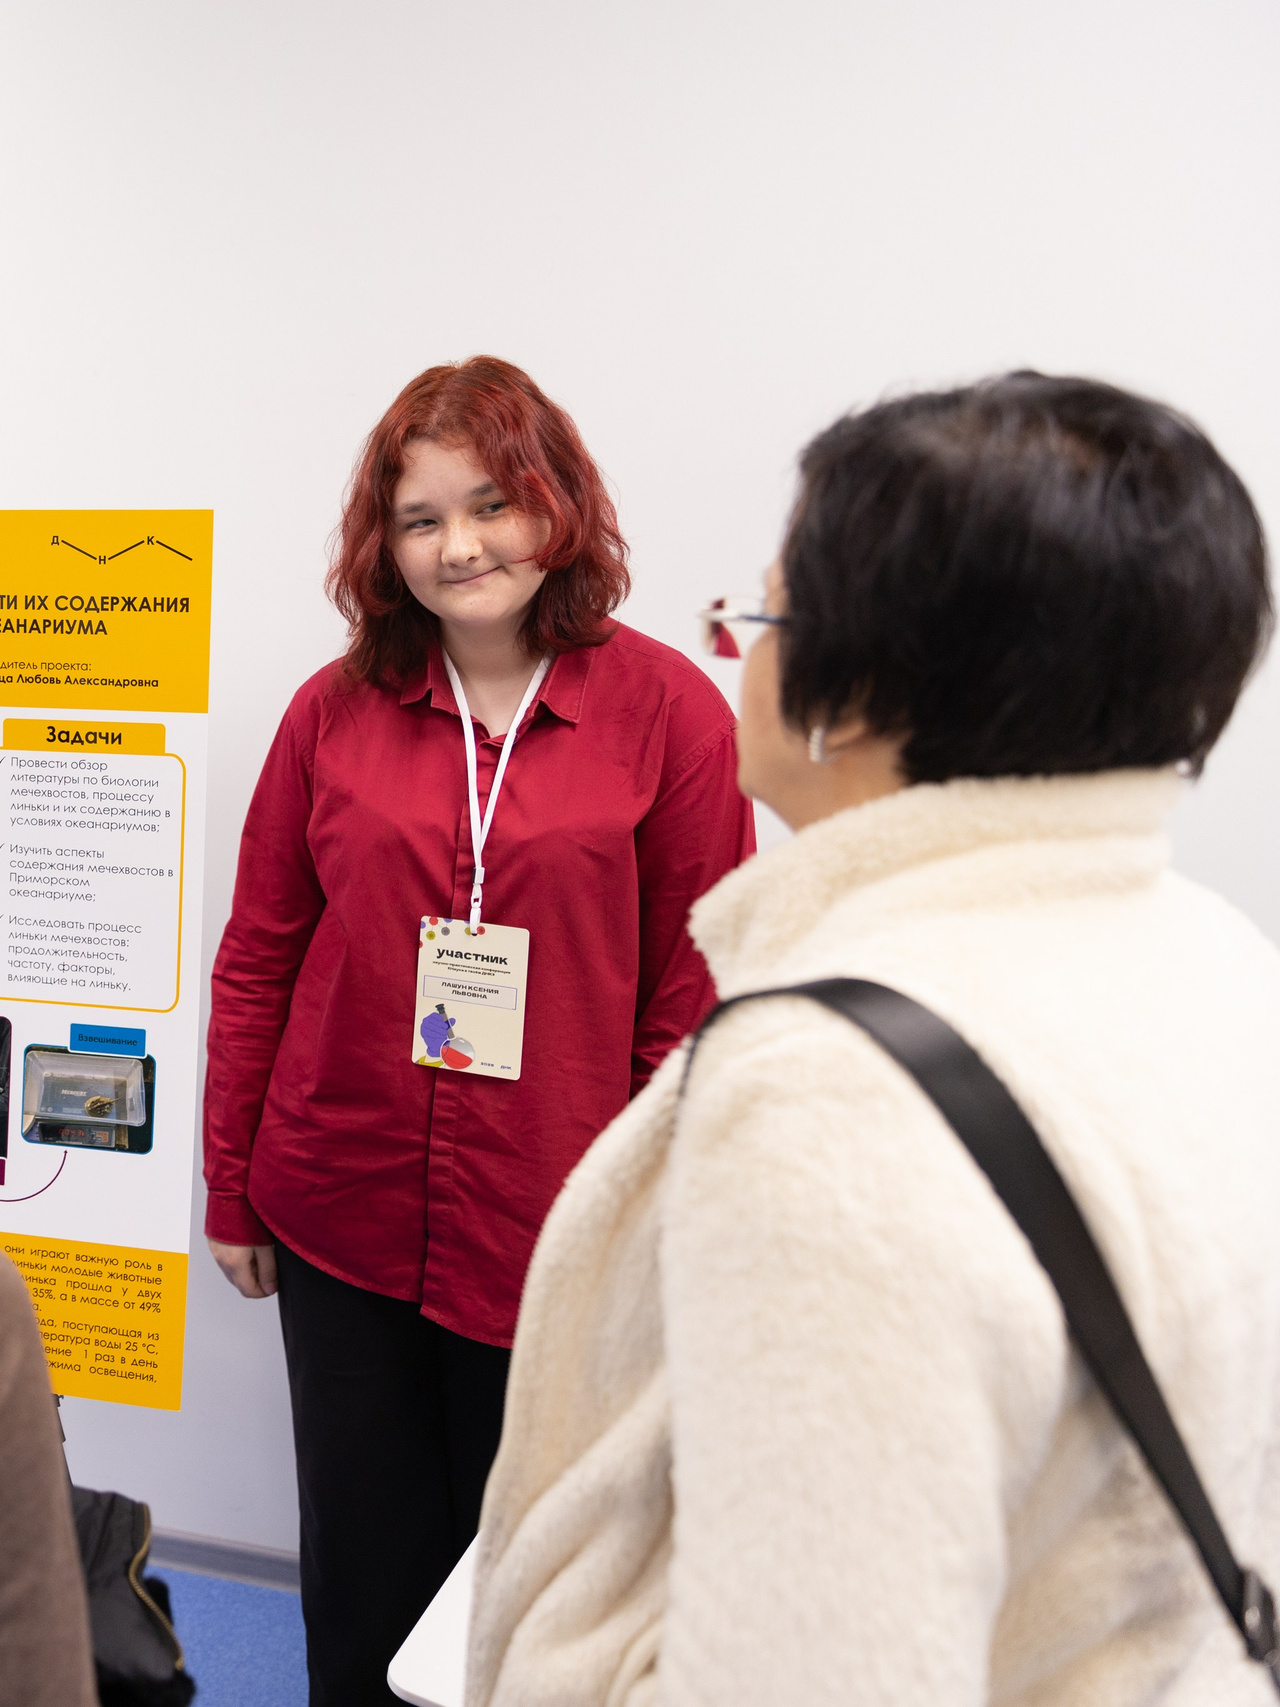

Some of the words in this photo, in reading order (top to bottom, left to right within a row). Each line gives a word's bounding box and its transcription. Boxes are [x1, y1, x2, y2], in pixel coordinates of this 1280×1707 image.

[24, 594, 48, 609] ИХ
[54, 594, 189, 612] СОДЕРЖАНИЯ
[41, 660, 92, 672] проекта:
[17, 674, 61, 685] Любовь
[64, 675, 158, 688] Александровна
[46, 726, 122, 745] Задачи
[11, 757, 67, 769] Провести
[71, 759, 108, 772] обзор
[11, 774, 79, 786] литературы
[83, 777, 98, 785] по
[101, 776, 159, 787] биологии
[11, 789, 89, 800] мечехвостов,
[93, 791, 154, 804] процессу
[11, 803, 49, 812] линьки
[80, 806, 161, 819] содержанию
[10, 818, 62, 828] условиях
[65, 820, 160, 833] океанариумов;
[10, 844, 52, 856] Изучить
[56, 848, 104, 859] аспекты
[10, 860, 84, 872] содержания
[88, 864, 164, 877] мечехвостов
[10, 873, 90, 887] Приморском
[9, 889, 96, 902] океанариуме;
[9, 915, 85, 930] Исследовать
[88, 922, 142, 934] процесс
[9, 932, 47, 941] линьки
[51, 935, 130, 947] мечехвостов:
[8, 946, 128, 962] продолжительность,
[437, 948, 508, 965] участник
[8, 960, 54, 971] частоту,
[58, 961, 115, 975] факторы,
[8, 974, 68, 986] влияющие
[71, 979, 85, 987] на
[89, 980, 131, 992] линьку.
[468, 985, 499, 994] КСЕНИЯ
[452, 990, 487, 999] ЛЬВОВНА
[78, 1033, 138, 1046] Взвешивание
[4, 1245, 25, 1255] они
[30, 1248, 70, 1260] играют
[75, 1253, 119, 1267] важную
[125, 1259, 152, 1270] роль
[158, 1263, 162, 1271] в
[51, 1265, 103, 1278] молодые
[107, 1272, 162, 1285] животные
[66, 1279, 112, 1293] прошла
[122, 1286, 128, 1296] у
[137, 1288, 162, 1299] двух
[32, 1288, 55, 1300] 35%,
[60, 1292, 67, 1300] а
[72, 1294, 76, 1302] в
[80, 1295, 119, 1307] массе
[124, 1301, 135, 1309] от
[139, 1302, 161, 1314] 49%
[63, 1320, 142, 1339] поступающая
[148, 1331, 159, 1340] из
[94, 1339, 121, 1350] воды
[125, 1341, 138, 1351] 25
[42, 1346, 72, 1357] ение
[95, 1351, 115, 1364] раз
[131, 1359, 158, 1369] день
[89, 1365, 157, 1383] освещения,
